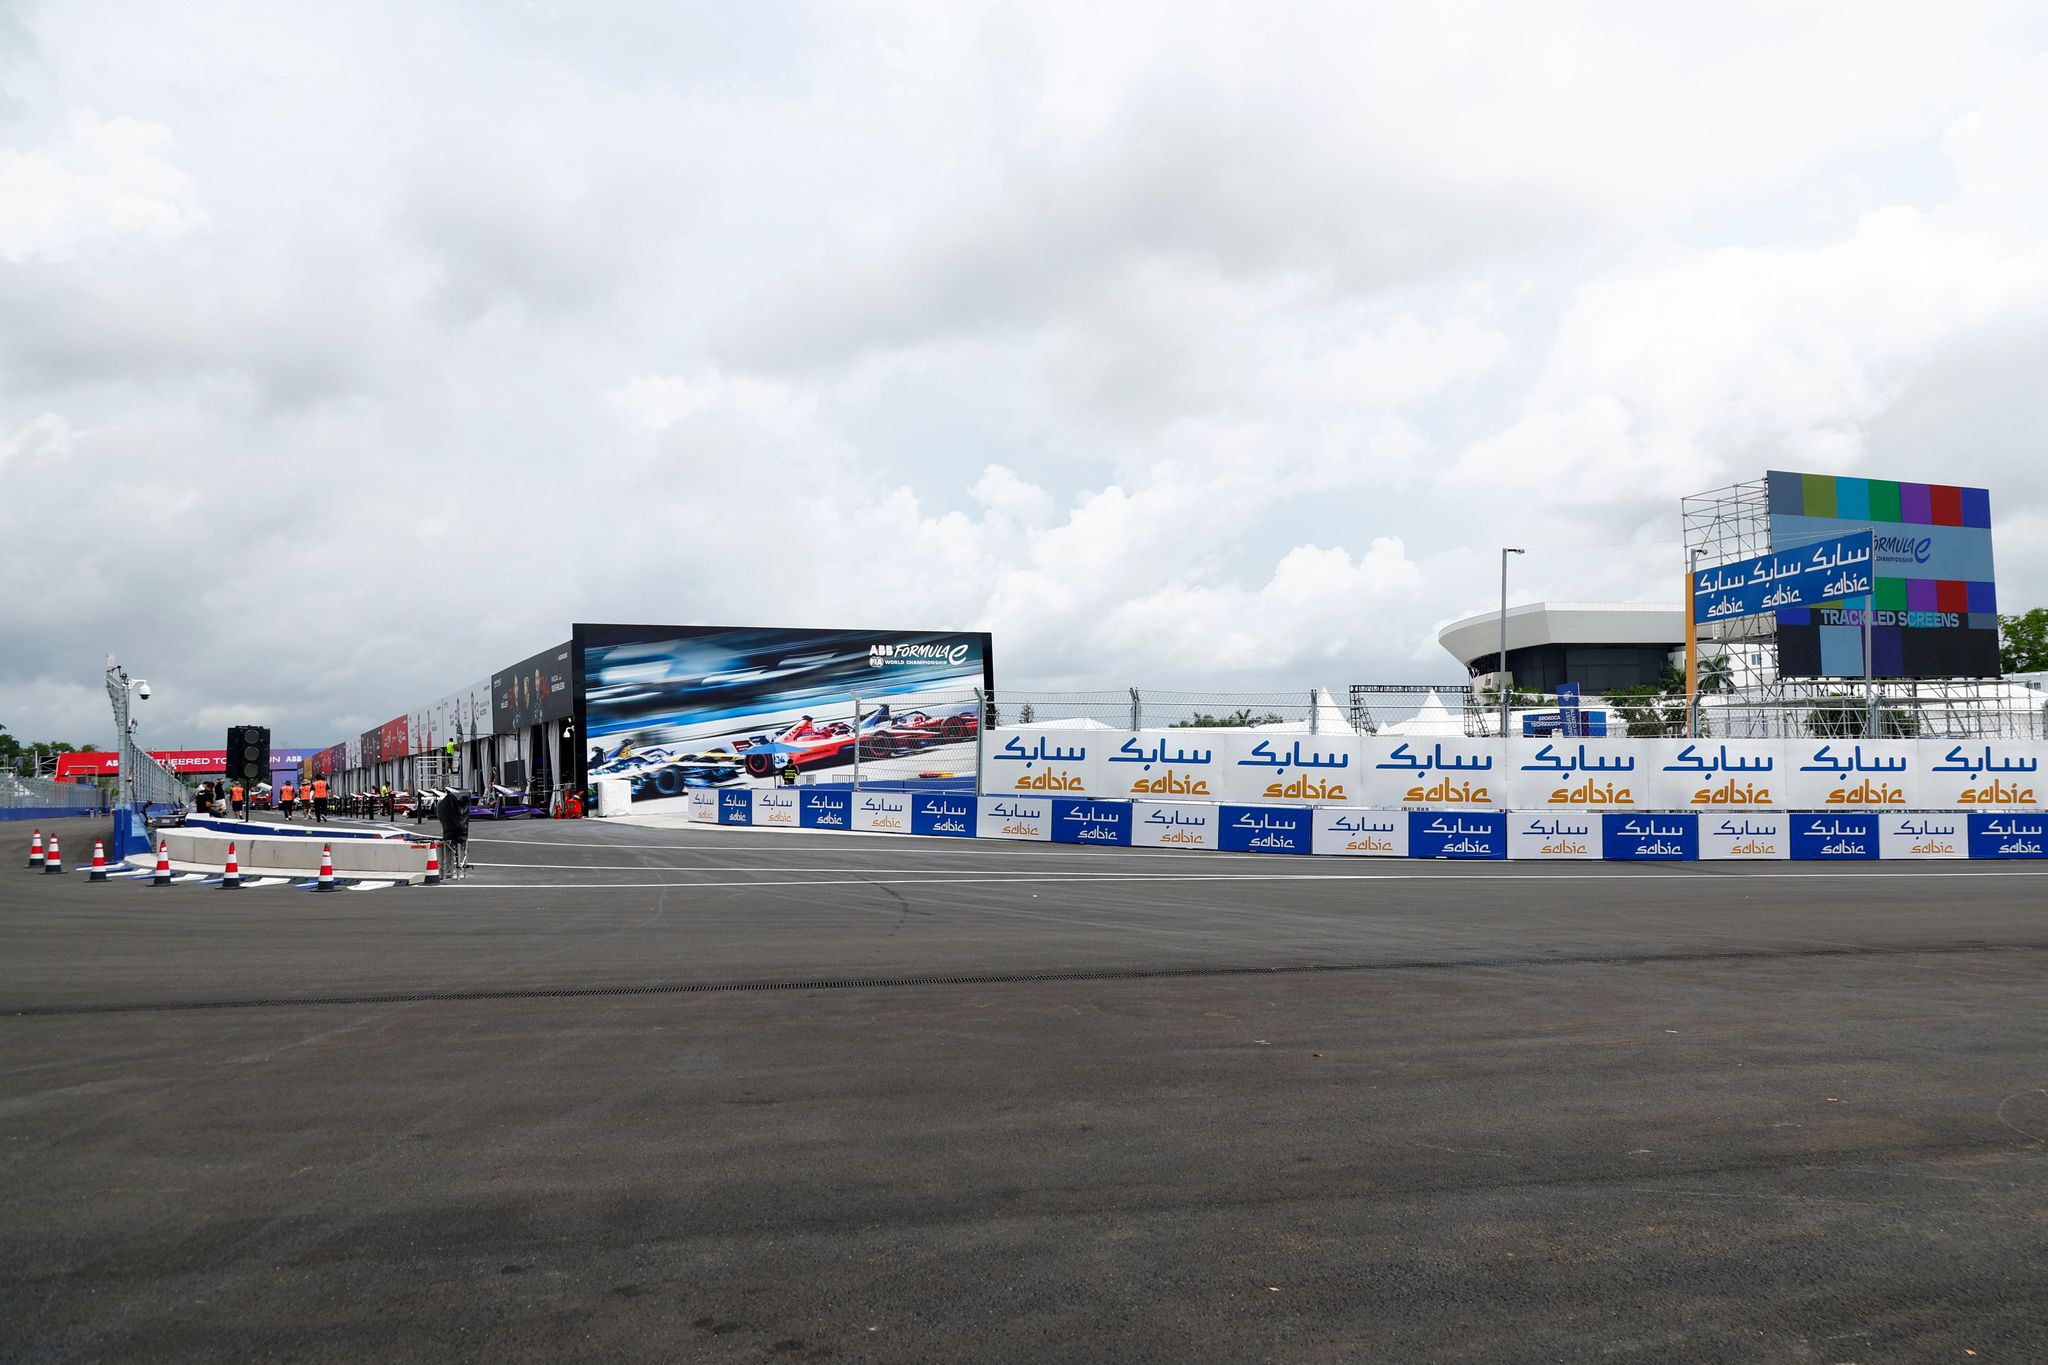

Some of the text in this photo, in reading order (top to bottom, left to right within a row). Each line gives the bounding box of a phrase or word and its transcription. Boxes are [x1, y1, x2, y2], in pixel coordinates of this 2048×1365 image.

[1873, 535, 1915, 555] ORMULA
[1707, 571, 1870, 617] sabic sabic sabic
[1820, 609, 1866, 625] TRACK
[1898, 612, 1959, 627] SCREENS
[869, 645, 894, 656] ABB
[894, 644, 951, 658] FORMULA
[1014, 767, 1085, 791] sabic
[1131, 770, 1211, 795] sabic
[1262, 774, 1348, 800] sabic
[1402, 776, 1492, 803] sabic
[1547, 777, 1634, 804] sabic
[1690, 778, 1773, 804] sabic
[1825, 779, 1906, 804] sabic
[1956, 779, 2037, 804] sabic
[767, 810, 792, 823] sabic
[816, 812, 843, 825] sabic
[871, 815, 902, 828] sabic
[932, 818, 966, 832] sabic
[1001, 821, 1039, 836] sabic
[1077, 825, 1118, 840] sabic
[1160, 829, 1204, 844] sabic
[1249, 832, 1295, 848] sabic
[1345, 835, 1393, 851] sabic
[1441, 838, 1492, 853] sabic
[1540, 839, 1588, 854] sabic
[1635, 840, 1683, 855] sabic
[1731, 839, 1775, 855] sabic
[1820, 839, 1866, 854] sabic
[1910, 839, 1954, 854] sabic
[1998, 839, 2042, 854] sabic
